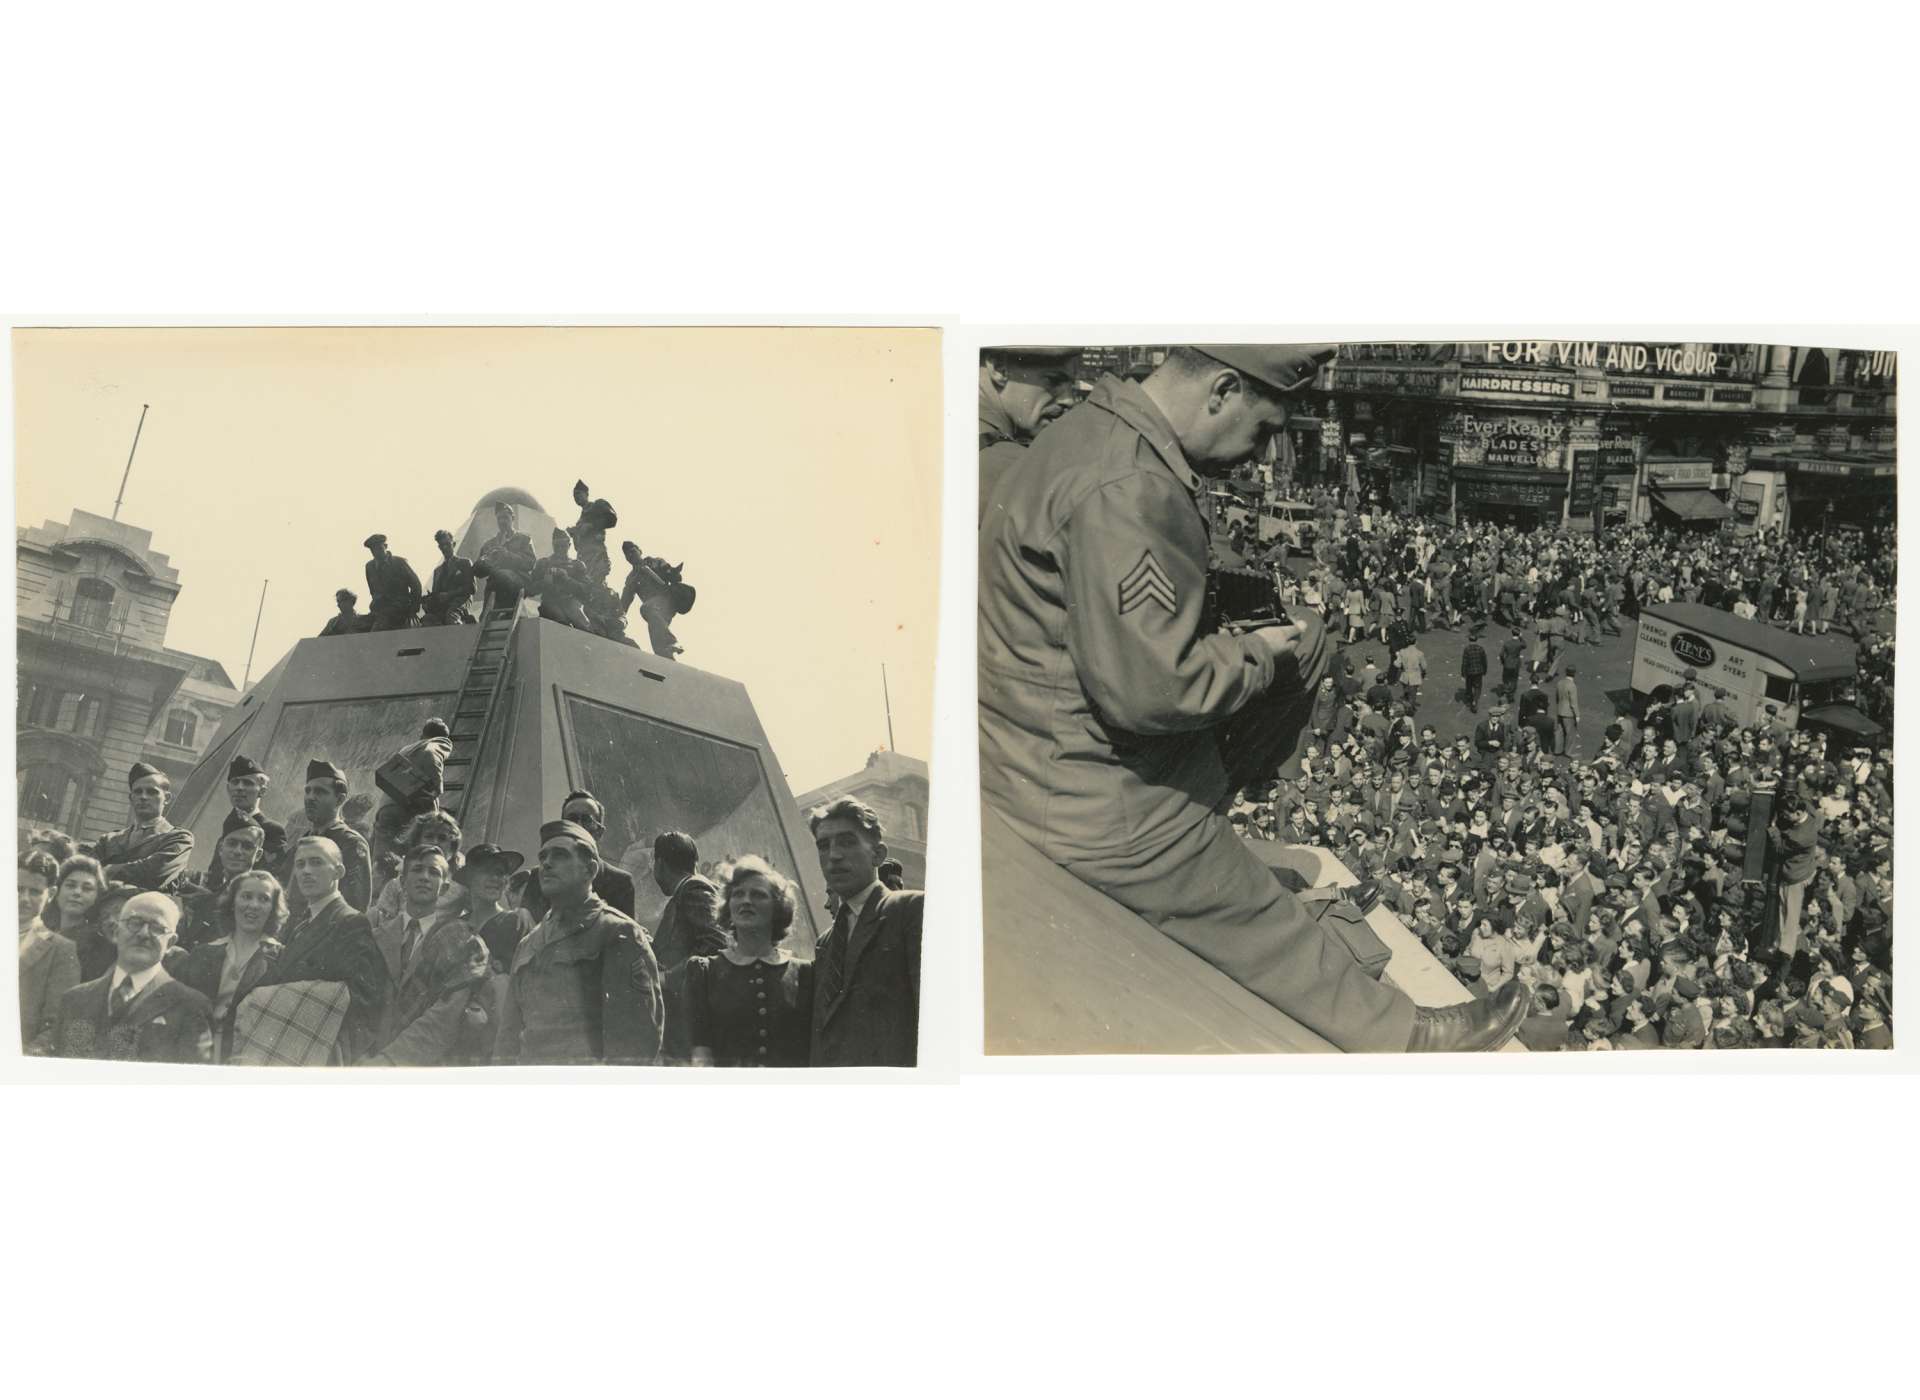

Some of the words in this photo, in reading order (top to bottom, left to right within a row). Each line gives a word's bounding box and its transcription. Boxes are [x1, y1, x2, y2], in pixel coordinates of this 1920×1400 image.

[1487, 342, 1541, 362] FOR
[1557, 342, 1598, 367] VIM
[1605, 345, 1648, 371] AND
[1655, 346, 1717, 375] VIGOUR
[1461, 377, 1571, 395] HAIRDRESSERS
[1481, 438, 1538, 451] BLADES
[1642, 624, 1667, 636] FRENCH
[1639, 632, 1667, 648] CLEANERS
[1728, 655, 1745, 667] ART
[1722, 664, 1747, 679] DYERS
